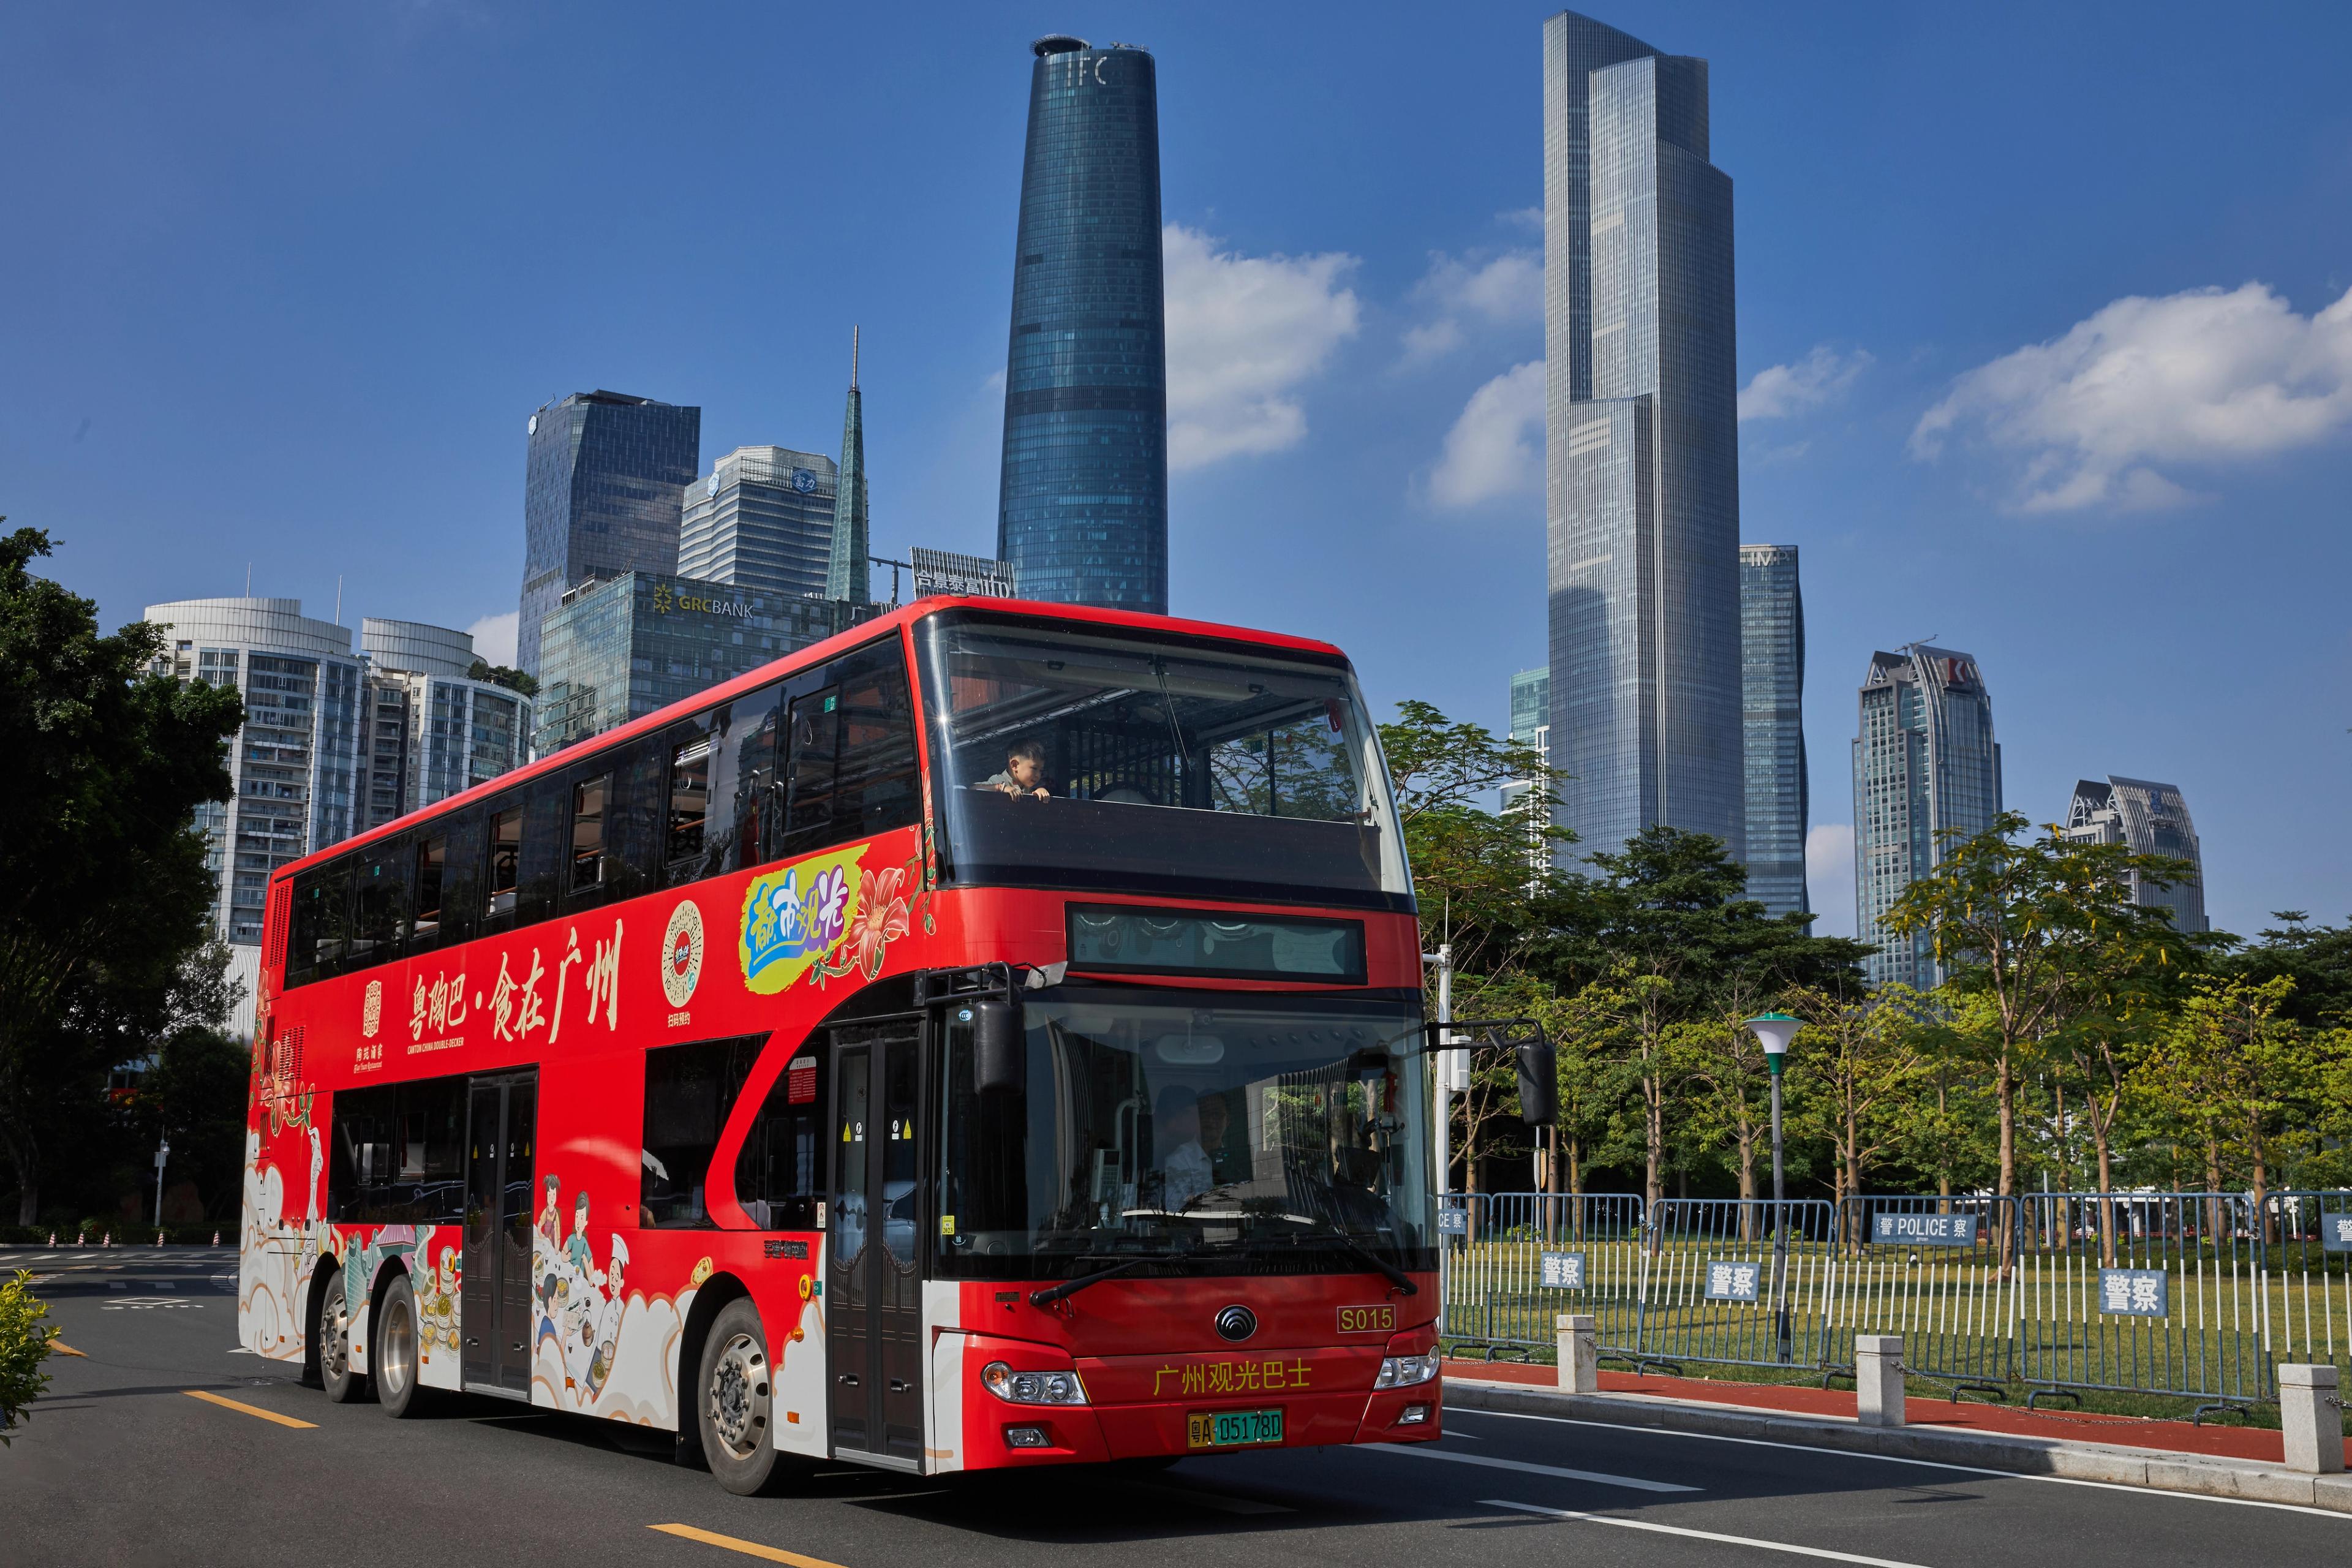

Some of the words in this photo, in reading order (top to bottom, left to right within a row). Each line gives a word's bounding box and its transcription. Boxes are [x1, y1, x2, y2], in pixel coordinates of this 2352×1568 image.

[1068, 56, 1107, 87] IFC
[794, 474, 816, 489] 富力
[679, 595, 753, 619] GRCBANK
[750, 867, 849, 954] 都市观光
[668, 1011, 690, 1028] 扫码预约
[407, 1044, 422, 1055] CANTON
[422, 1042, 433, 1052] CHINA
[433, 1037, 464, 1050] DOUBLE-DECKER
[1453, 1213, 1461, 1228] 察
[1880, 1217, 1893, 1235] 警
[1898, 1218, 1948, 1236] POLICE
[1954, 1219, 1966, 1237] 察
[1544, 1256, 1578, 1285] 警察
[1712, 1265, 1754, 1296] 警察
[2105, 1275, 2158, 1311] 警察
[1341, 1309, 1392, 1330] S015
[1153, 1357, 1311, 1396] 广州观光巴士
